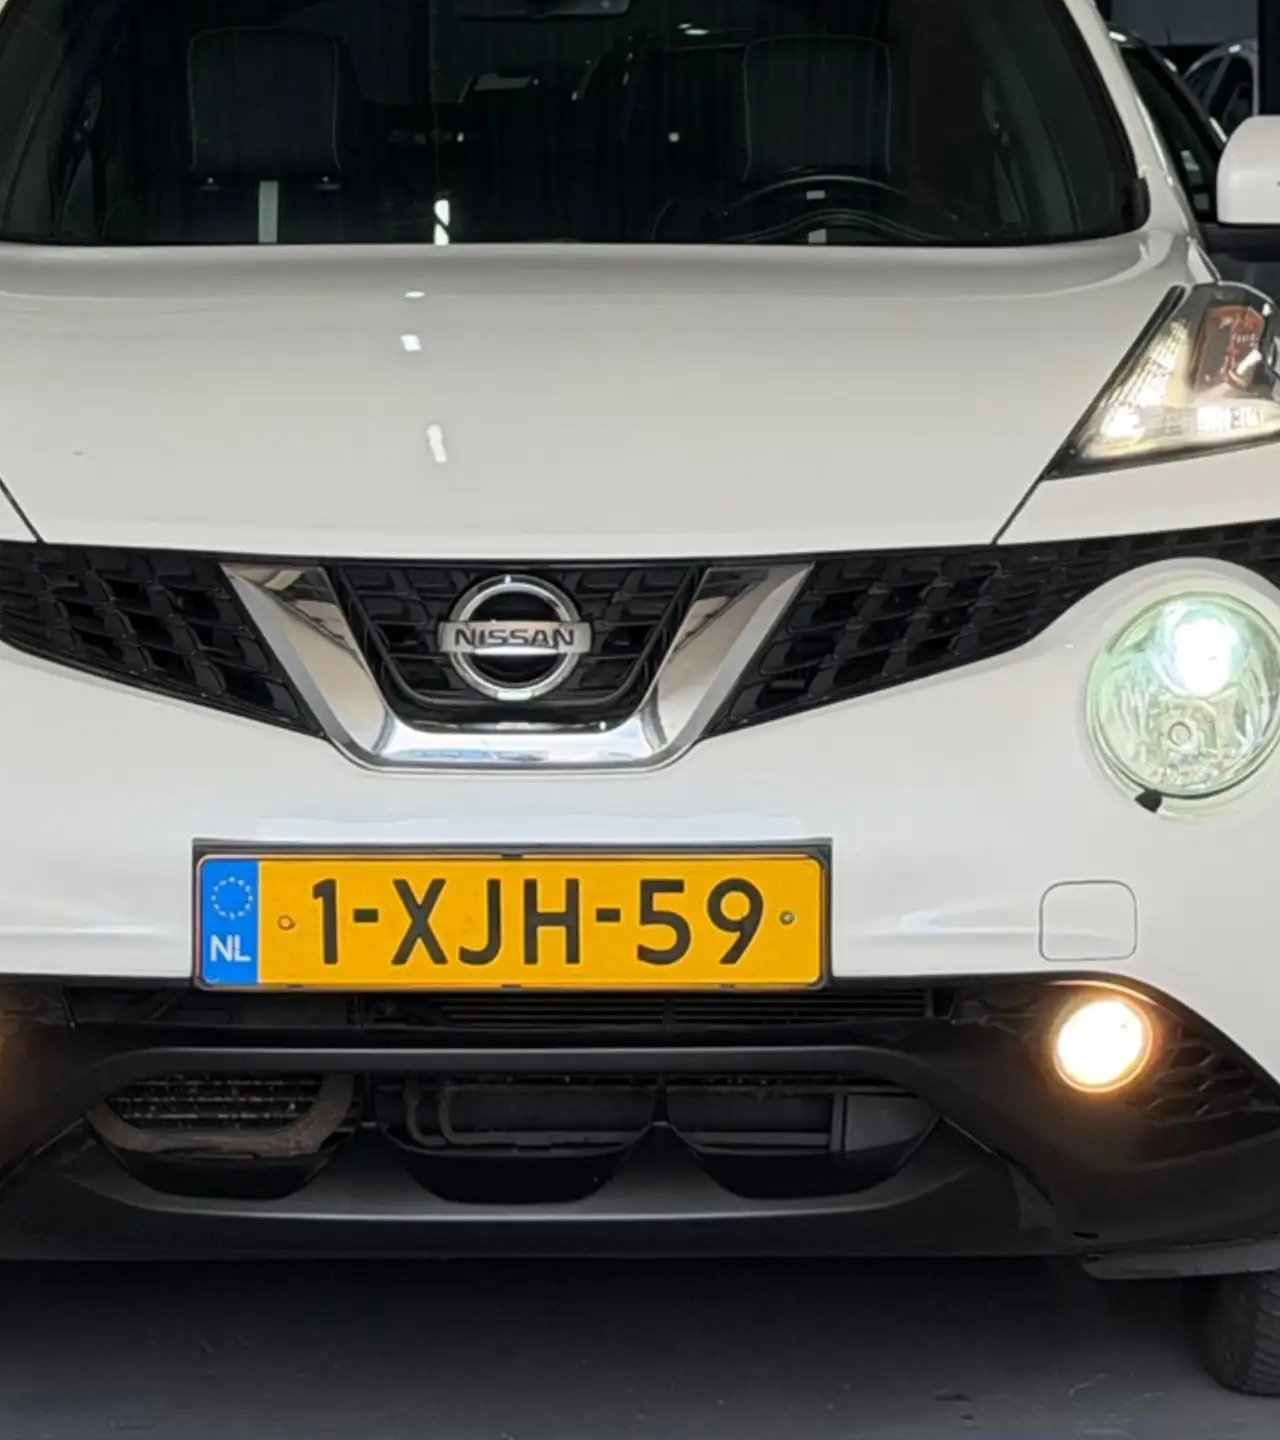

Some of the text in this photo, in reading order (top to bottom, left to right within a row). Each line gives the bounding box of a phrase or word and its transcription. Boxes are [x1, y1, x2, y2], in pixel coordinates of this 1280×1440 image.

[455, 628, 575, 647] NISSAN
[312, 878, 766, 967] 1-XJH-59
[210, 934, 251, 963] NL
